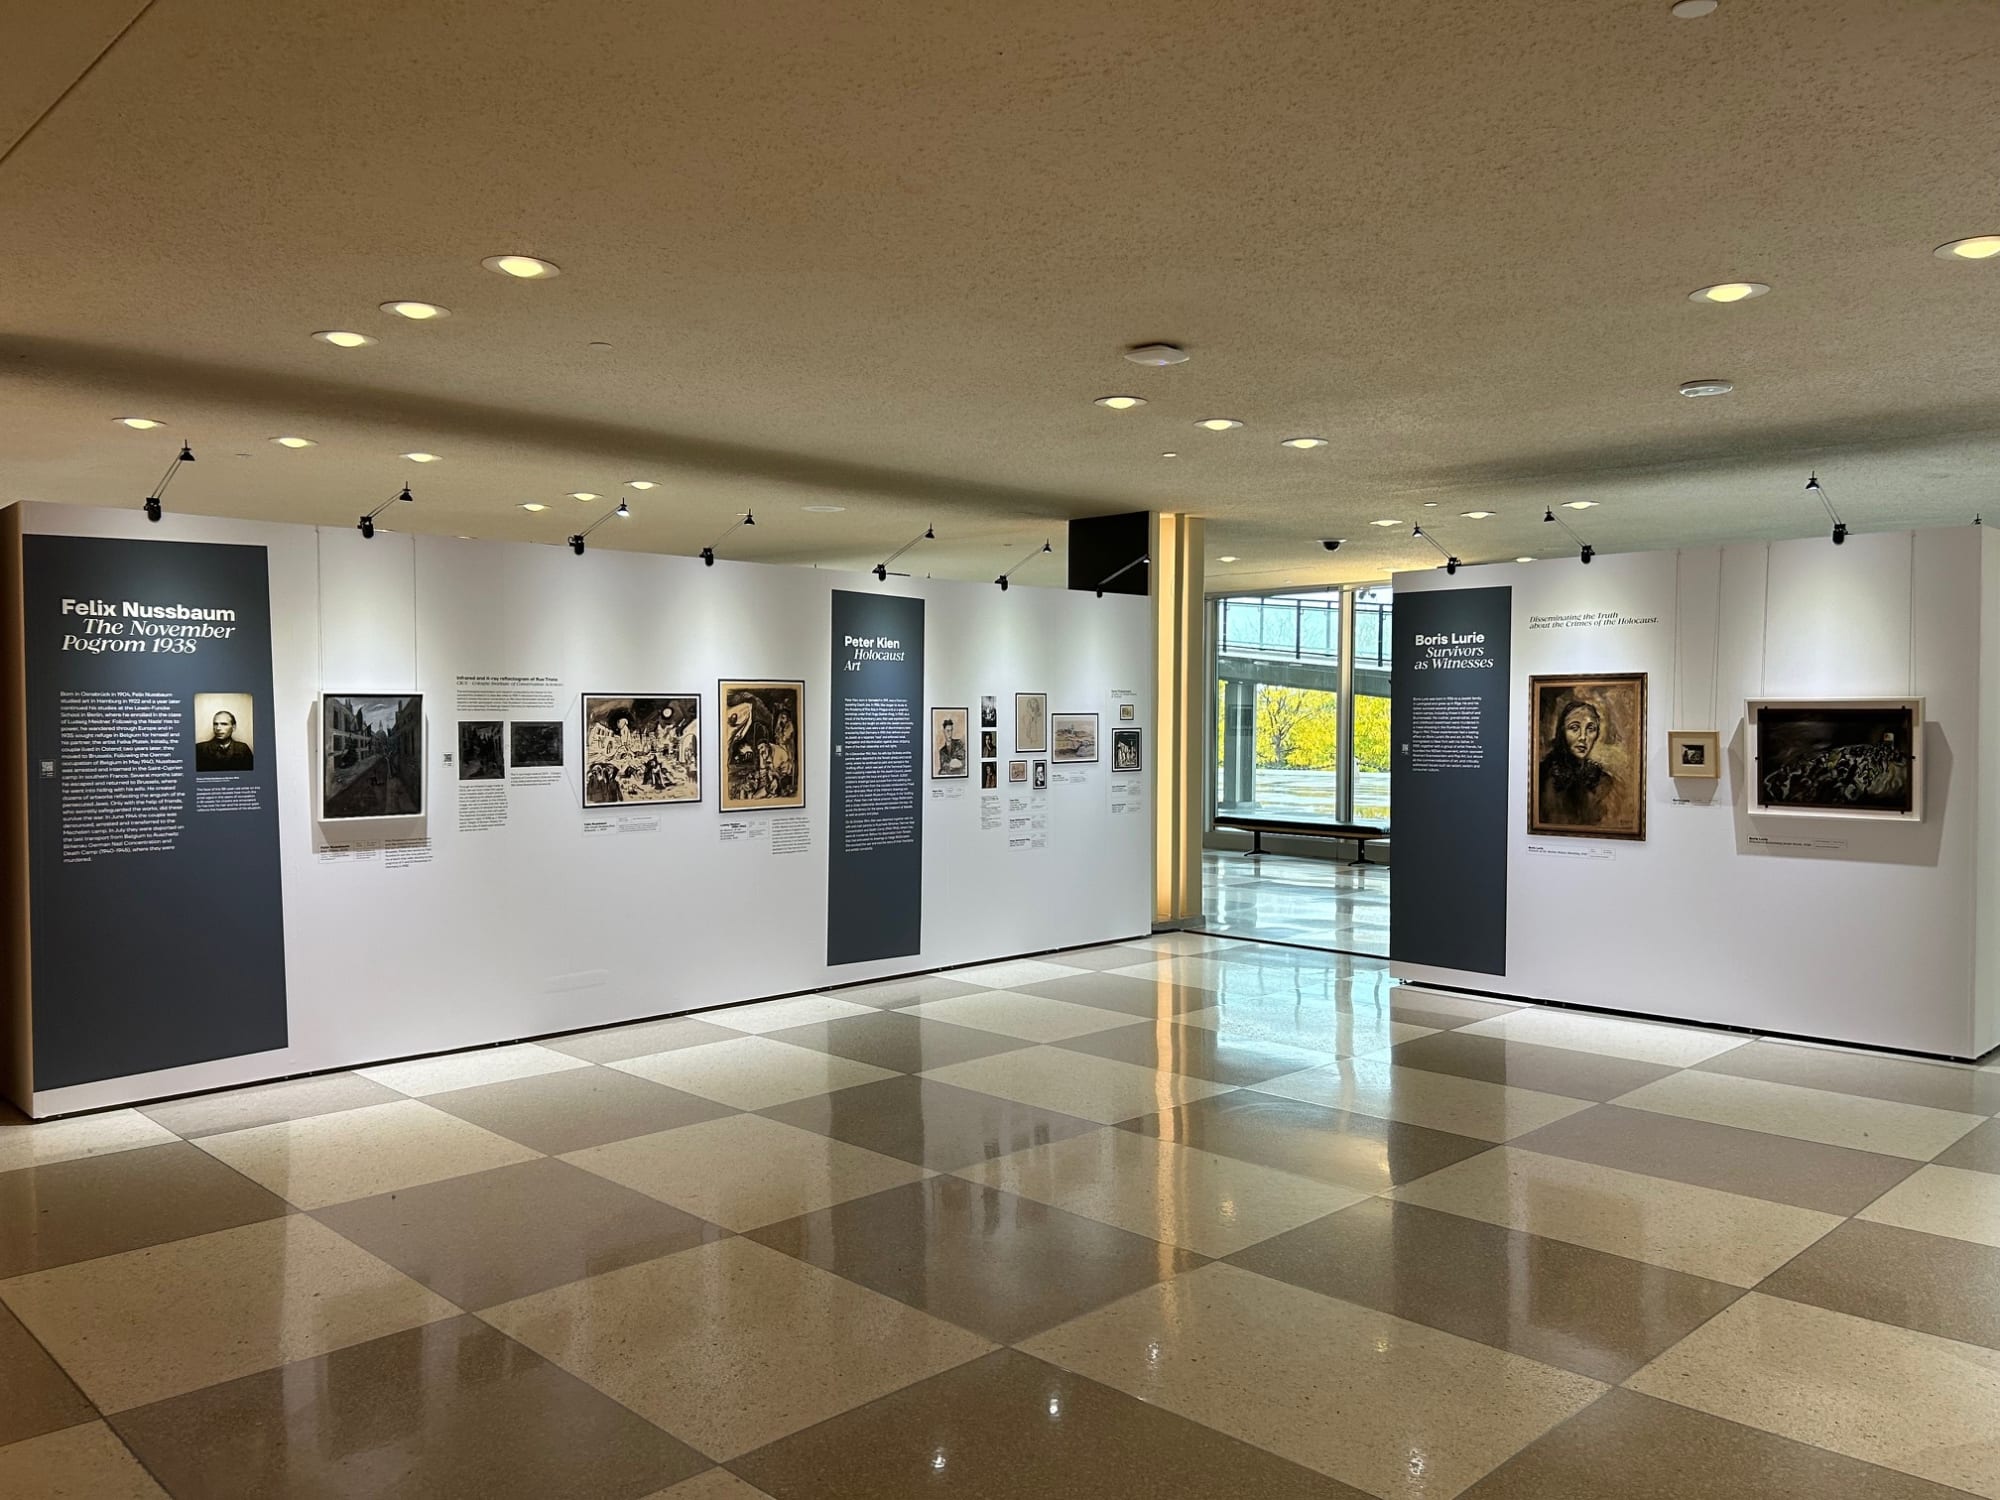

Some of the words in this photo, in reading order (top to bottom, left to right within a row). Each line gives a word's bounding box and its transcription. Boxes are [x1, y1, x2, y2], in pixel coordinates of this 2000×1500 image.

[61, 599, 117, 617] Felix
[122, 601, 236, 622] Nussbaum
[1530, 614, 1580, 622] Disseminating
[1566, 620, 1592, 628] Crimes
[83, 617, 124, 635] The
[129, 620, 236, 639] November
[61, 634, 145, 655] Pogrom
[151, 637, 197, 654] 1938
[844, 636, 874, 648] Peter
[876, 636, 900, 648] Kien
[1415, 634, 1448, 646] Boris
[1452, 632, 1484, 644] Lurie
[854, 648, 904, 661] Holocaust
[1426, 646, 1484, 658] Survivors
[844, 660, 860, 671] Art
[1414, 660, 1428, 670] as
[1432, 658, 1494, 669] Witnesses
